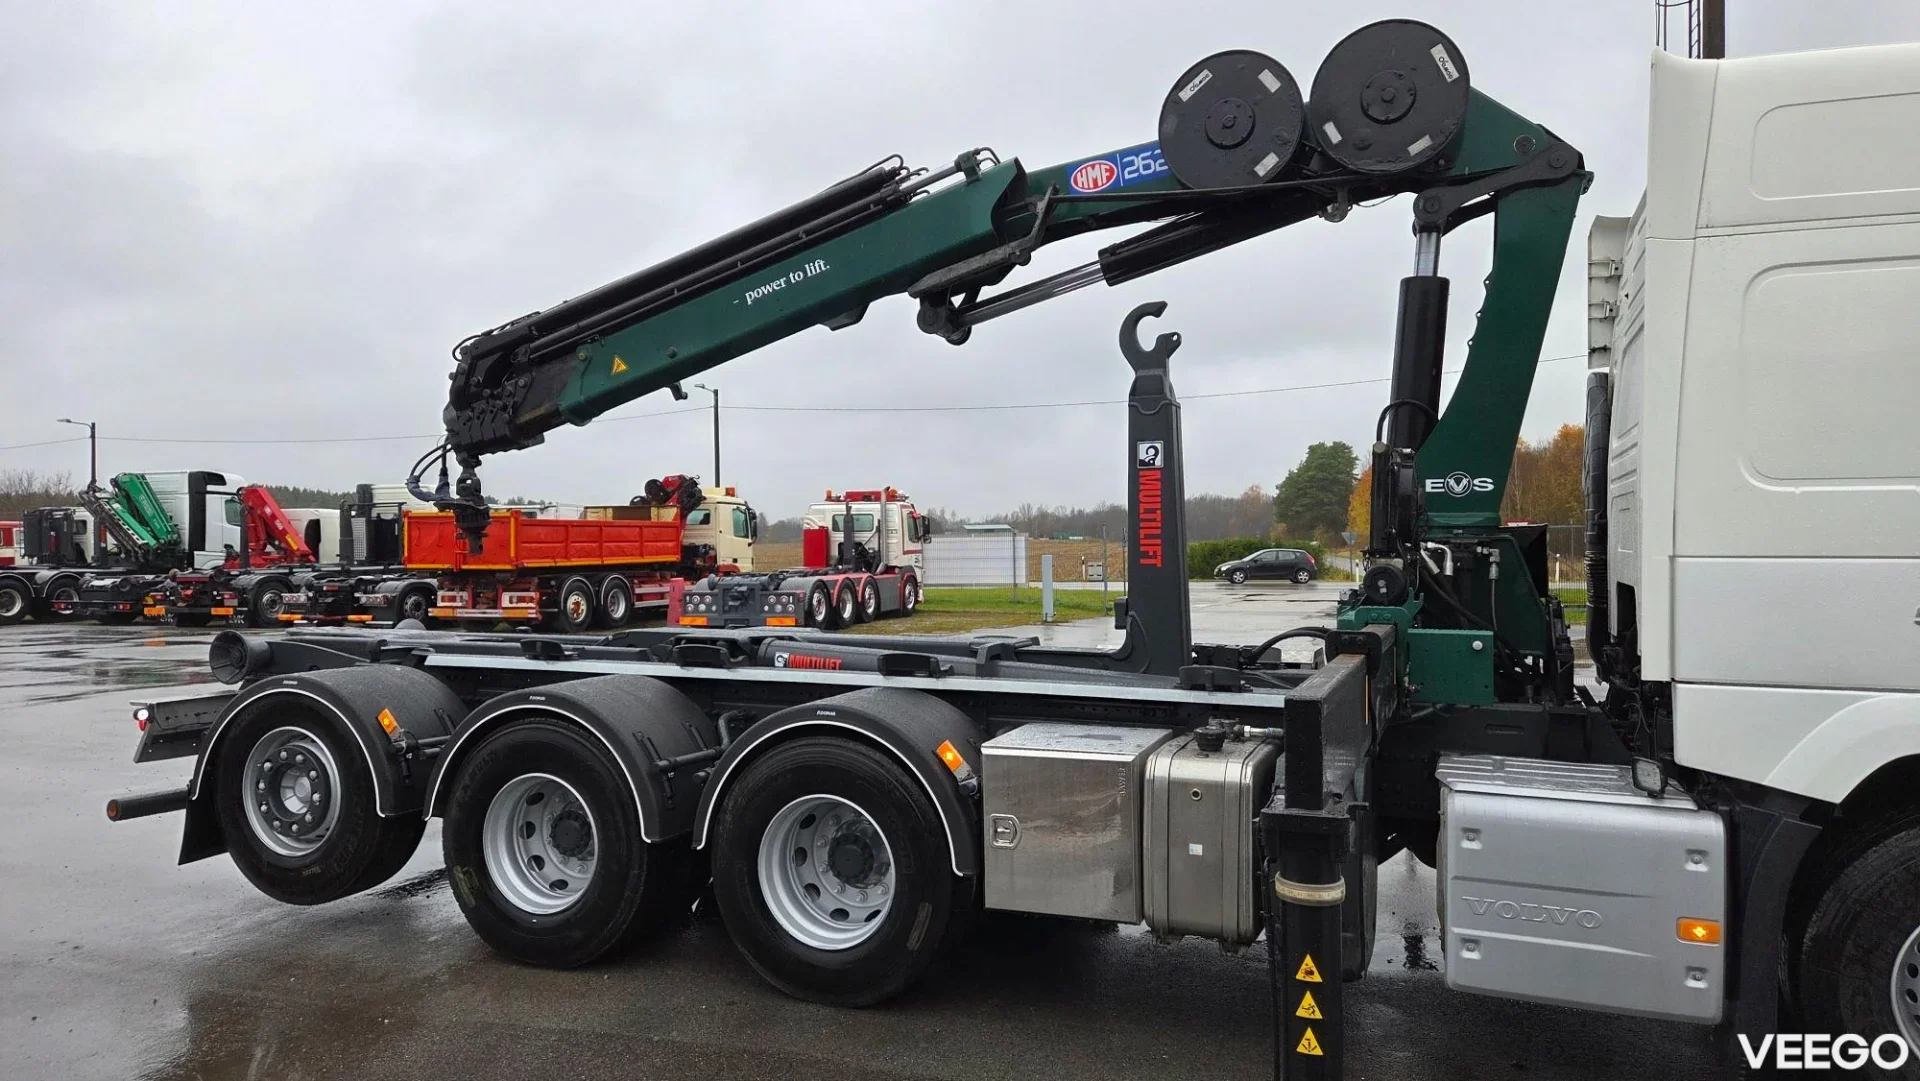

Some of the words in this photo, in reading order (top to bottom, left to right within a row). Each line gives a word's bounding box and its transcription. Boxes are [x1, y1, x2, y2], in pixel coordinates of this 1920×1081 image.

[1075, 163, 1111, 189] HMF
[744, 276, 787, 305] power
[788, 270, 804, 284] to
[804, 258, 831, 278] lift.
[1425, 471, 1495, 497] EVS
[1138, 469, 1162, 568] MULTILIFT
[789, 654, 842, 671] MULTILIFT
[1461, 895, 1604, 929] VOLVO
